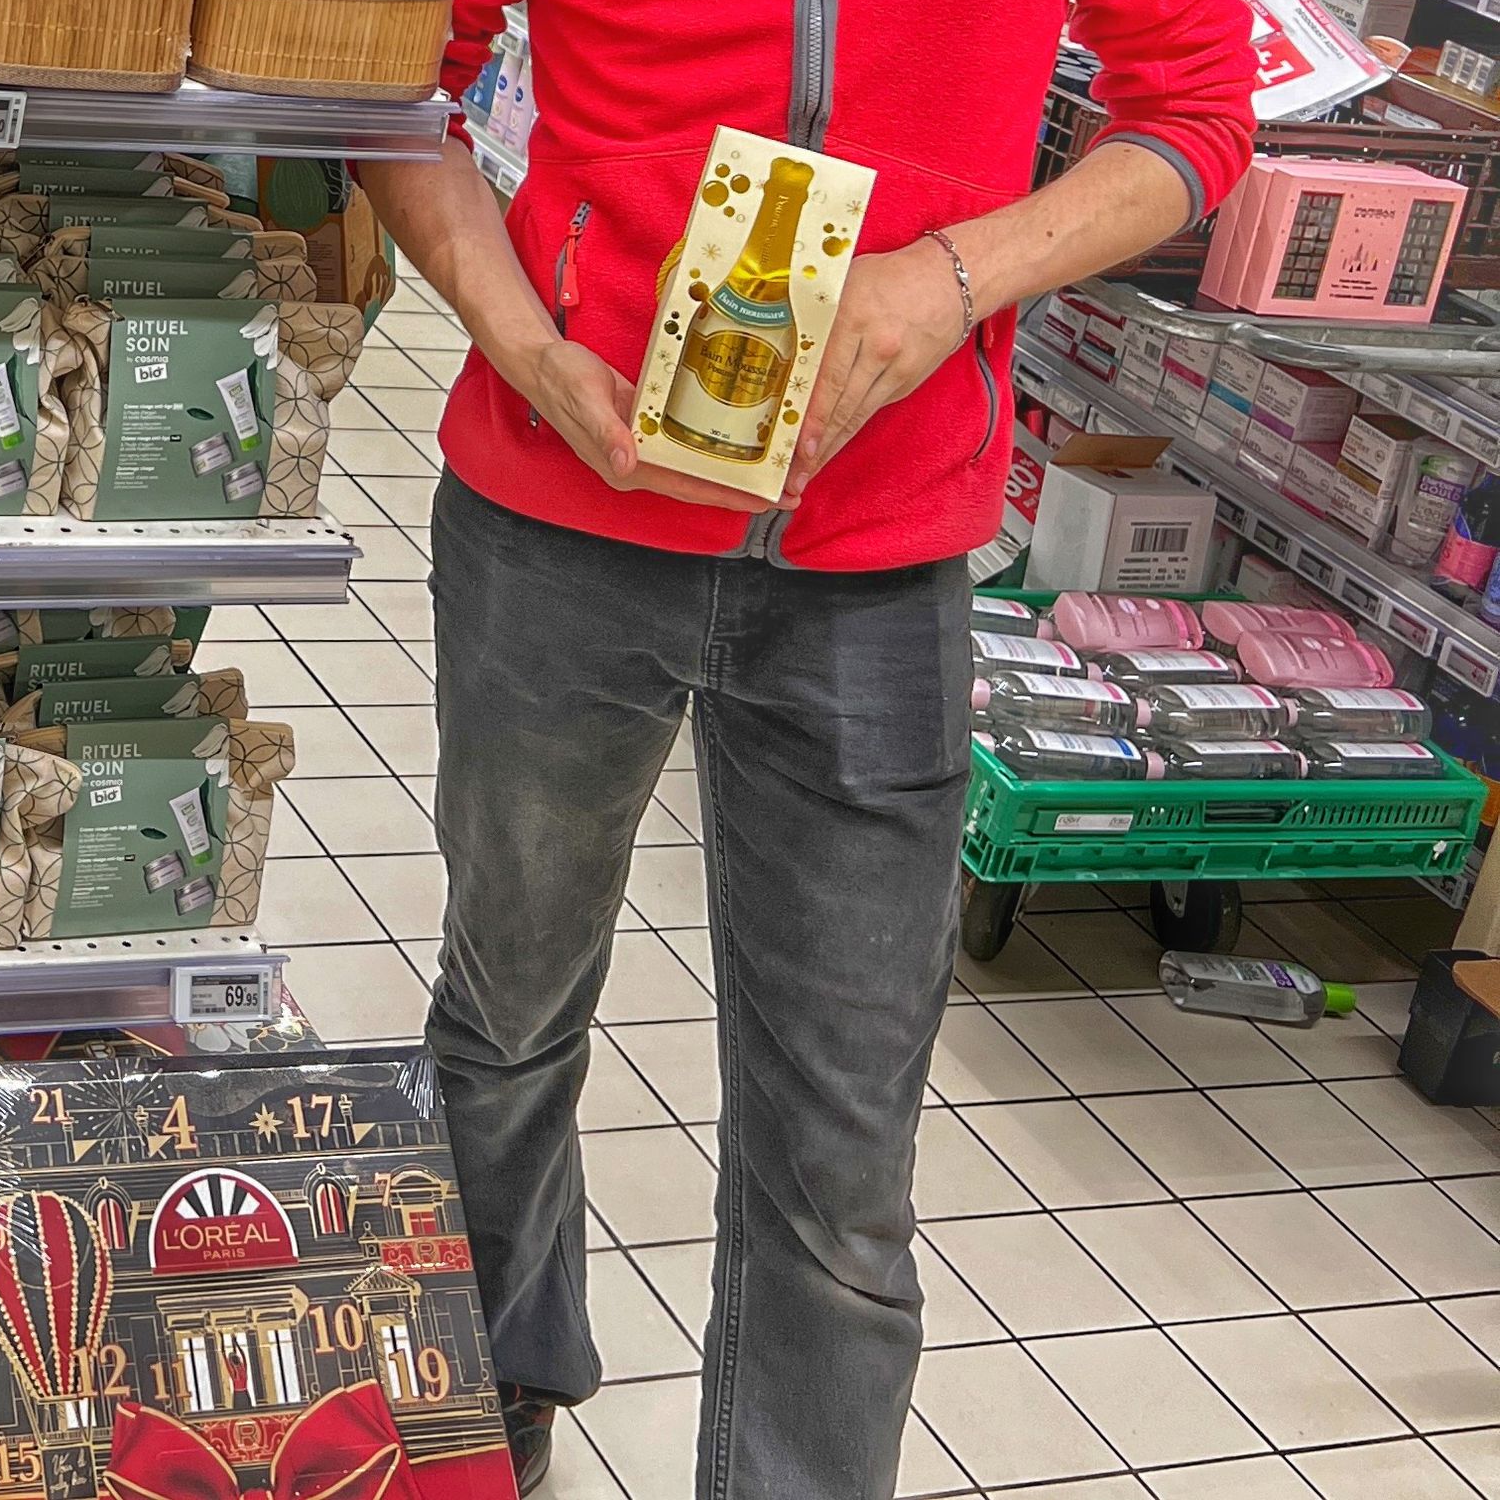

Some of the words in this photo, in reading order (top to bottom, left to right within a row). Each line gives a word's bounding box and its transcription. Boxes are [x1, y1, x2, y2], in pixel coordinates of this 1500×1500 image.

[718, 292, 738, 311] Bain
[740, 306, 786, 320] moussant
[127, 319, 189, 336] RITUEL
[126, 336, 170, 353] SOIN
[139, 366, 164, 381] bio
[82, 743, 142, 759] RITUEL
[81, 760, 124, 776] SOIN
[30, 1088, 67, 1126] 21
[288, 1096, 333, 1140] 17
[162, 1096, 196, 1152] 4
[162, 1221, 281, 1250] L'ORÉAL
[203, 1247, 246, 1260] PARIS
[309, 1304, 363, 1353] 10
[77, 1347, 130, 1397] 12
[391, 1348, 451, 1403] 19
